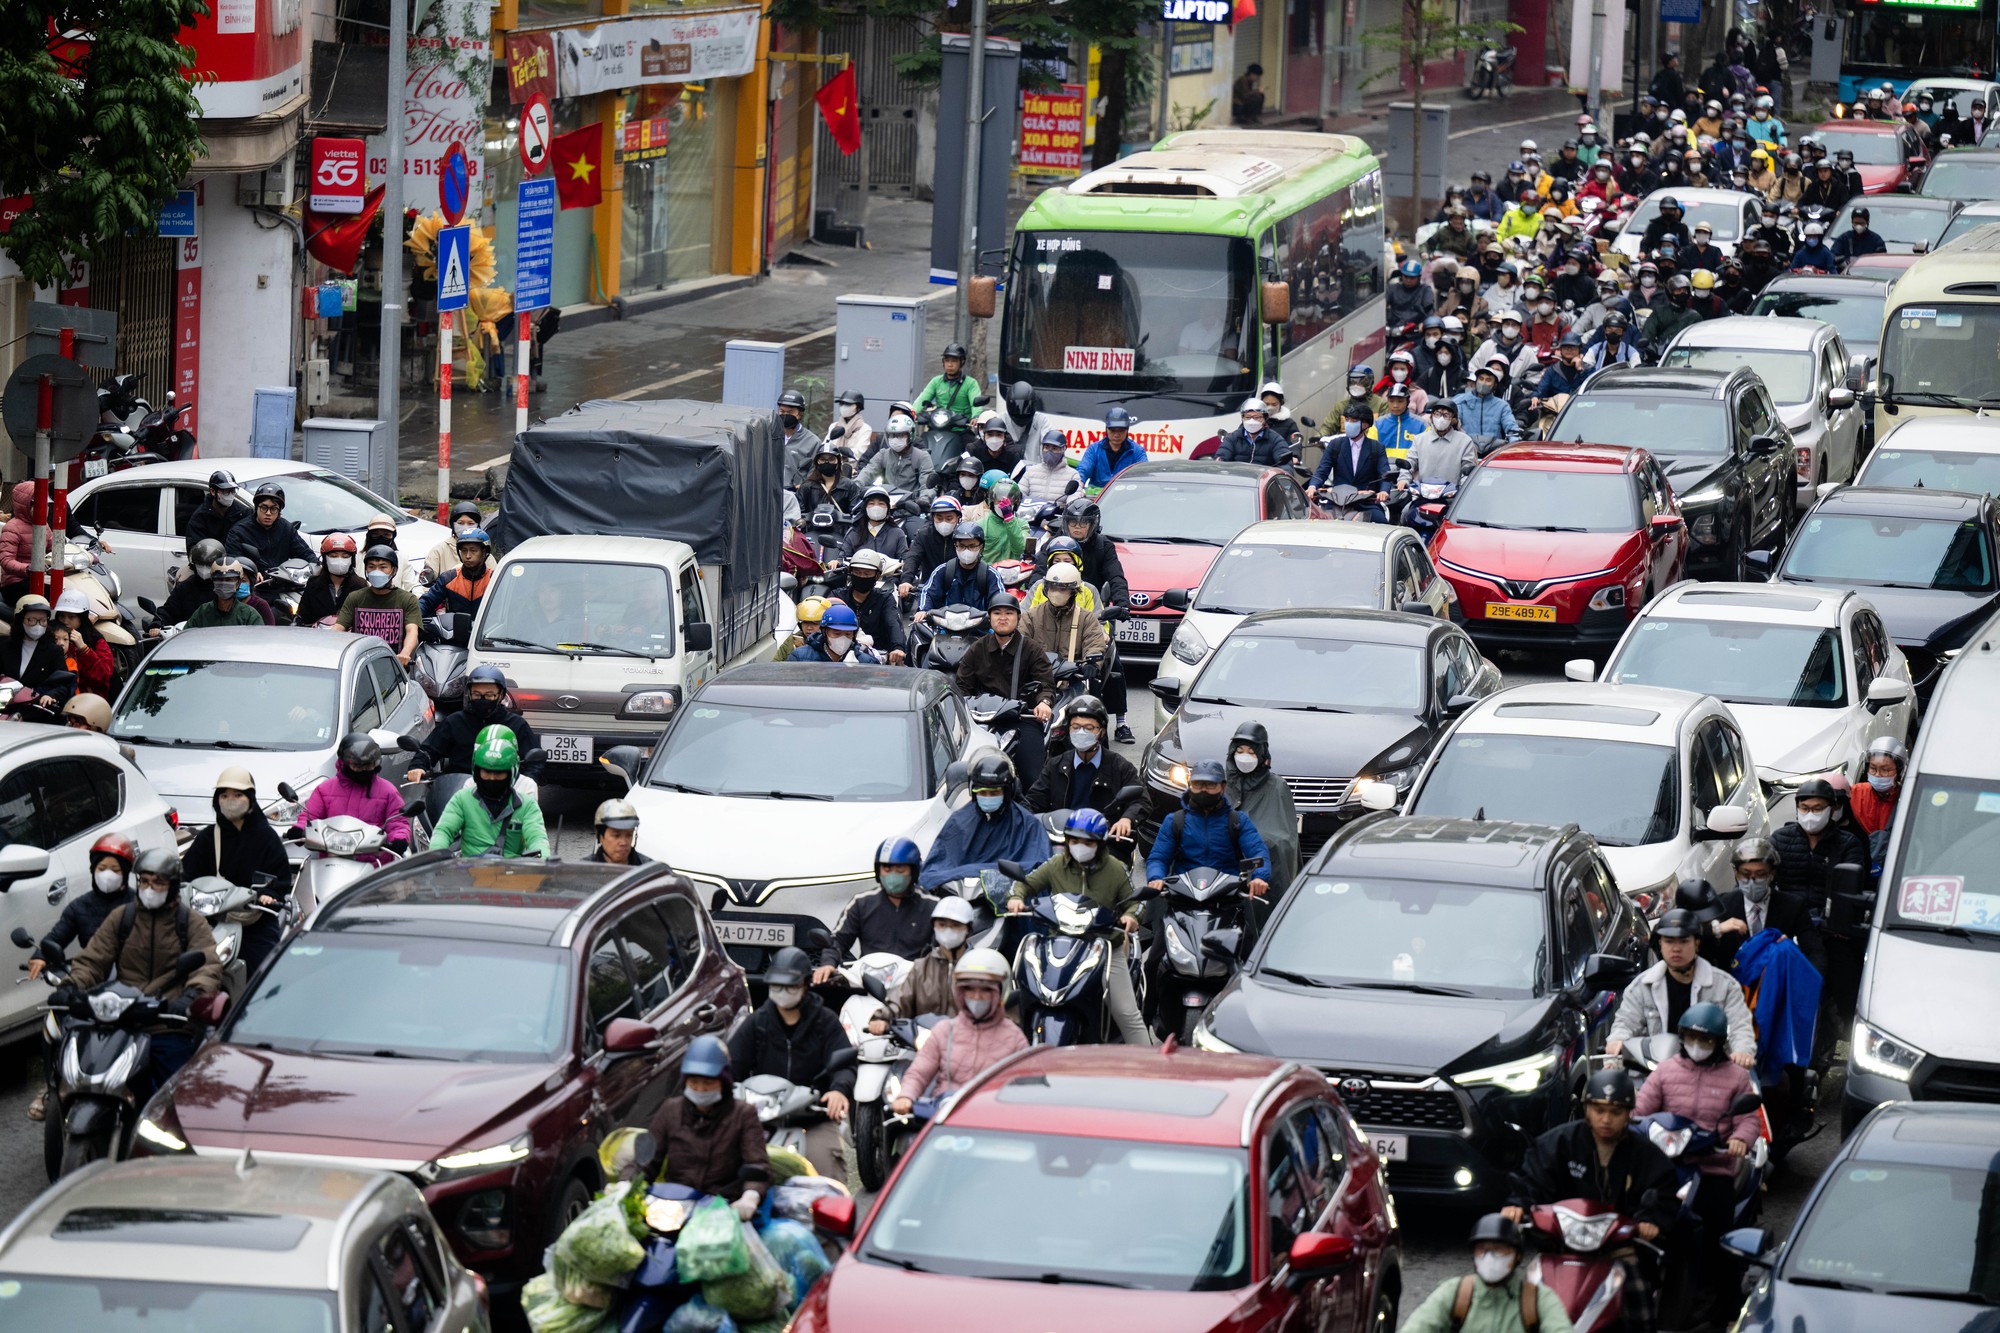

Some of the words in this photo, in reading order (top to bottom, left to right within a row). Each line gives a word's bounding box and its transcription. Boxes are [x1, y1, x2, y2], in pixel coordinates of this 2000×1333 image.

[1164, 0, 1229, 21] LAPTOP
[1023, 115, 1056, 131] GIÁC
[1024, 132, 1050, 147] XOA
[1052, 133, 1079, 148] BÓP
[325, 150, 359, 158] viettel
[317, 160, 358, 187] 5G
[1036, 239, 1046, 251] XE
[1066, 351, 1098, 370] NINH
[1101, 347, 1133, 371] BÌNH
[1059, 430, 1107, 454] MẠN
[1491, 606, 1550, 619] 29E-489.74
[360, 612, 400, 628] SQUARED2
[1128, 621, 1147, 630] 30G
[1120, 631, 1155, 641] 878.88
[623, 666, 664, 674] TOWNER
[556, 737, 578, 749] 29K
[547, 749, 587, 761] 095.85
